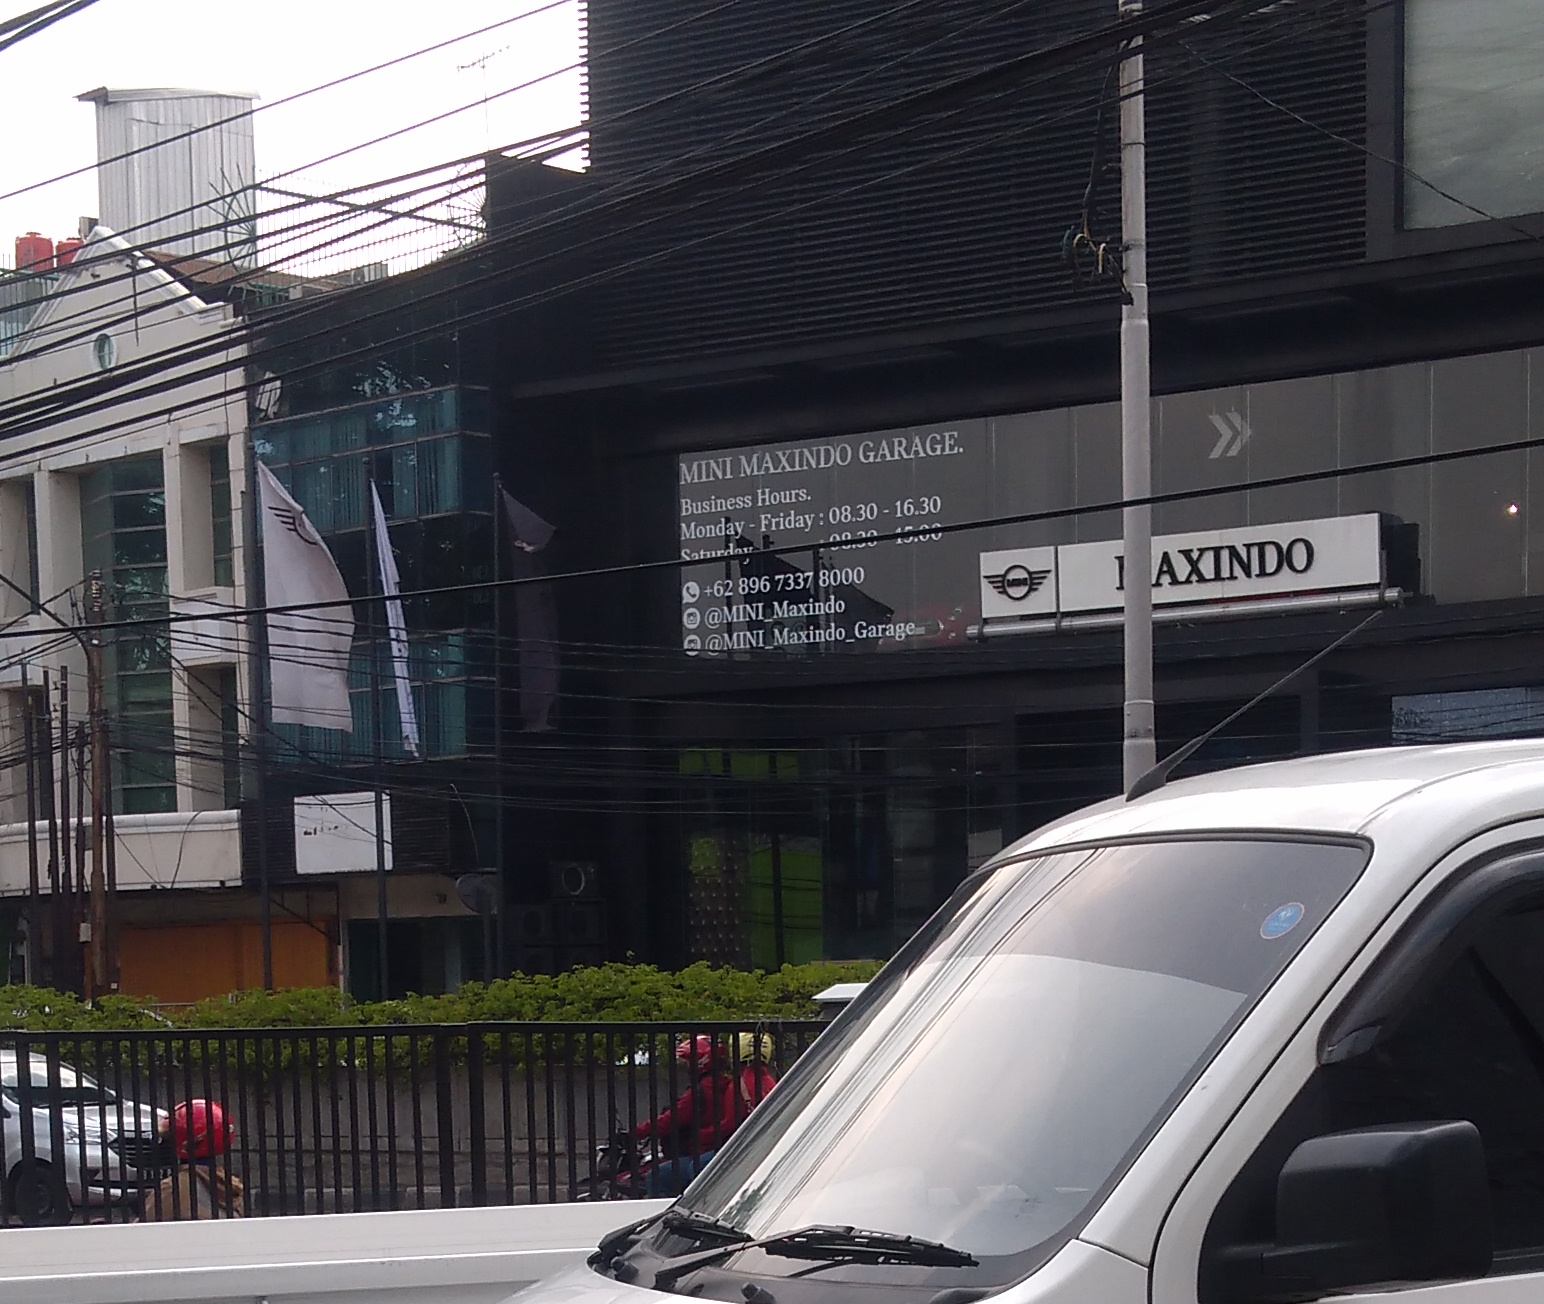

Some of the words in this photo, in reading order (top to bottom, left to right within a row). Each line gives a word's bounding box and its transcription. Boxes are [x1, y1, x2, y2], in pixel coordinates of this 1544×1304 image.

[680, 457, 733, 484] MINI
[739, 444, 852, 477] MAXINDO
[859, 432, 963, 463] GARAGE.
[681, 495, 752, 516] Business
[757, 487, 811, 507] Hours.
[681, 518, 745, 540] Monday
[760, 510, 815, 532] Friday
[829, 503, 877, 524] 08.30
[895, 496, 941, 517] 16.30
[704, 581, 733, 598] +62
[738, 576, 771, 595] 896
[775, 571, 814, 592] 7337
[819, 566, 865, 588] 8000
[1115, 538, 1315, 590] AXINDO
[706, 595, 845, 629] @MINI_Maxindo
